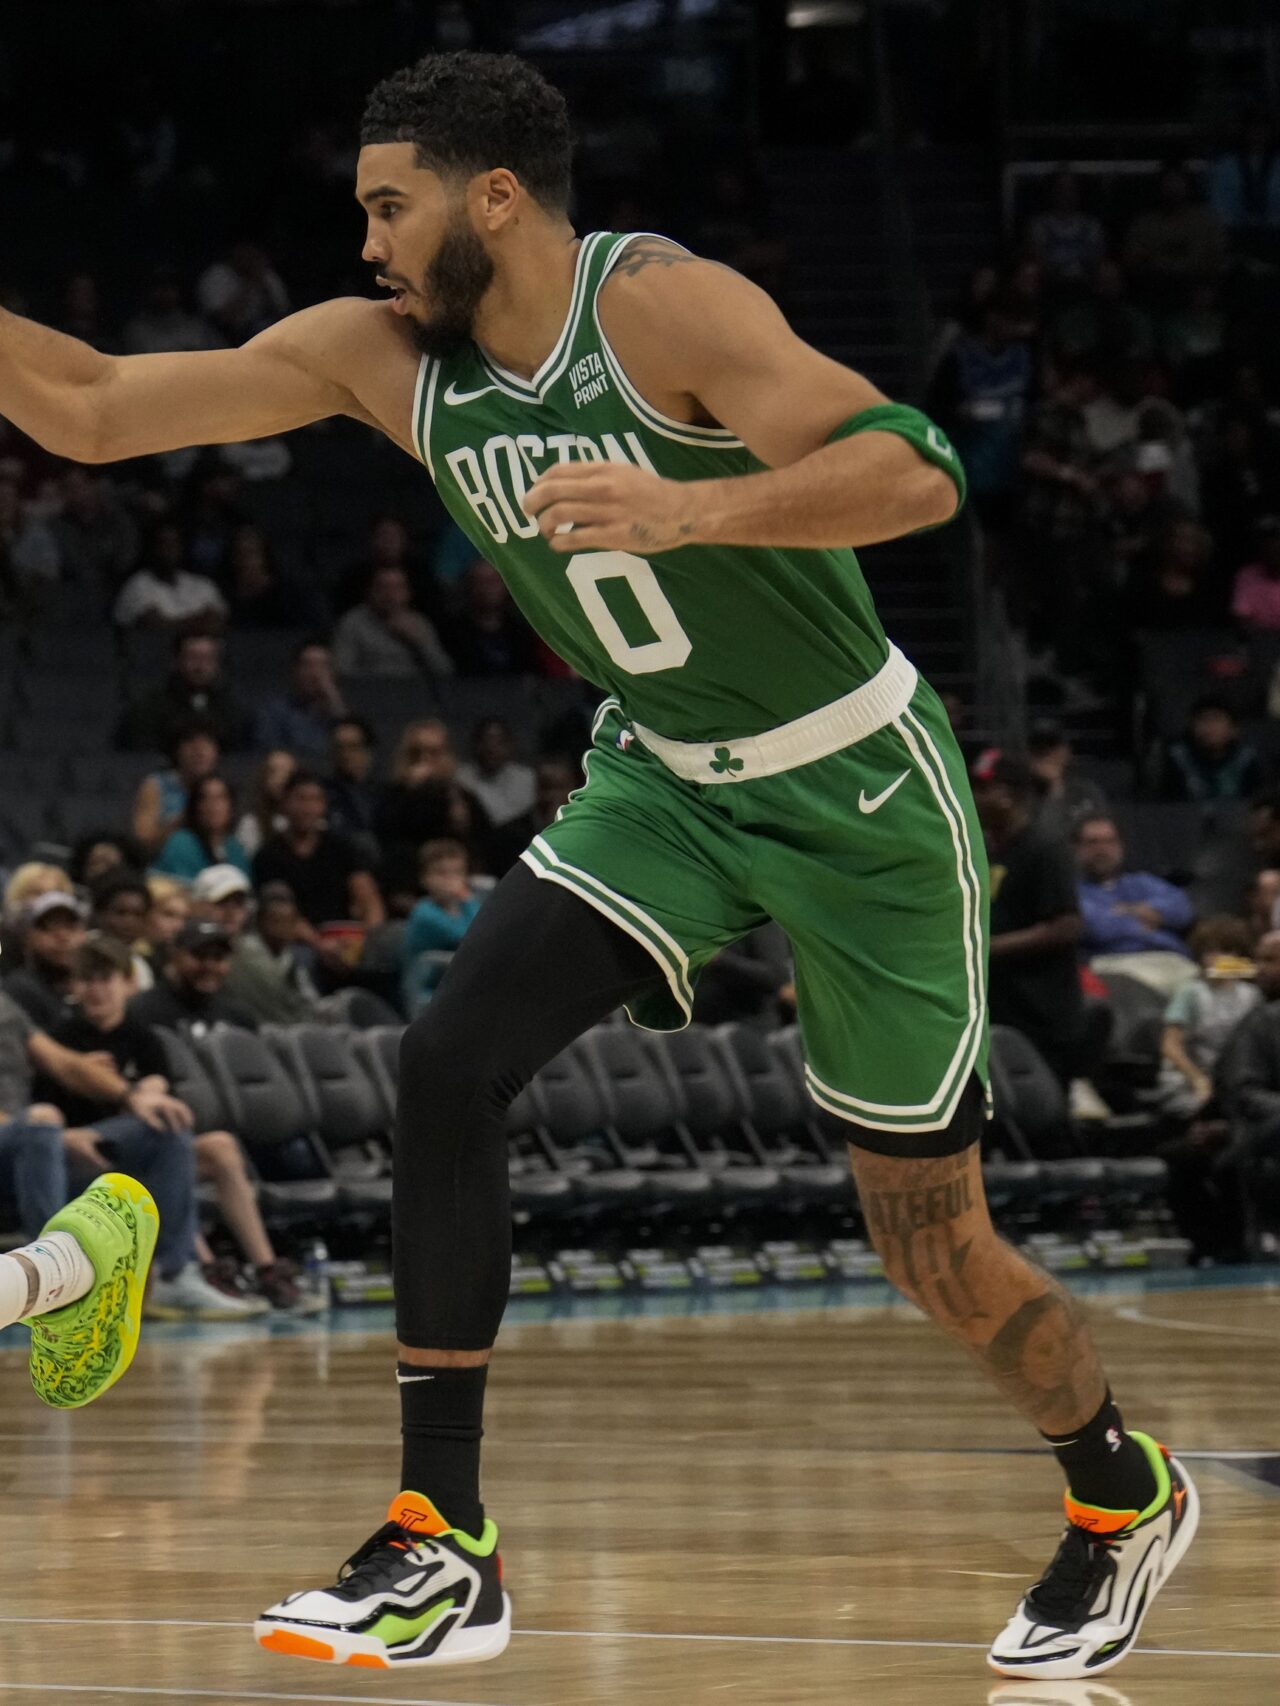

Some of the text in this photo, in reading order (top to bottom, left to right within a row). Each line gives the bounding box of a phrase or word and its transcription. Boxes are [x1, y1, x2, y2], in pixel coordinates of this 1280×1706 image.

[569, 352, 604, 390] VISTA
[574, 373, 608, 409] PRINT
[566, 550, 693, 675] 0
